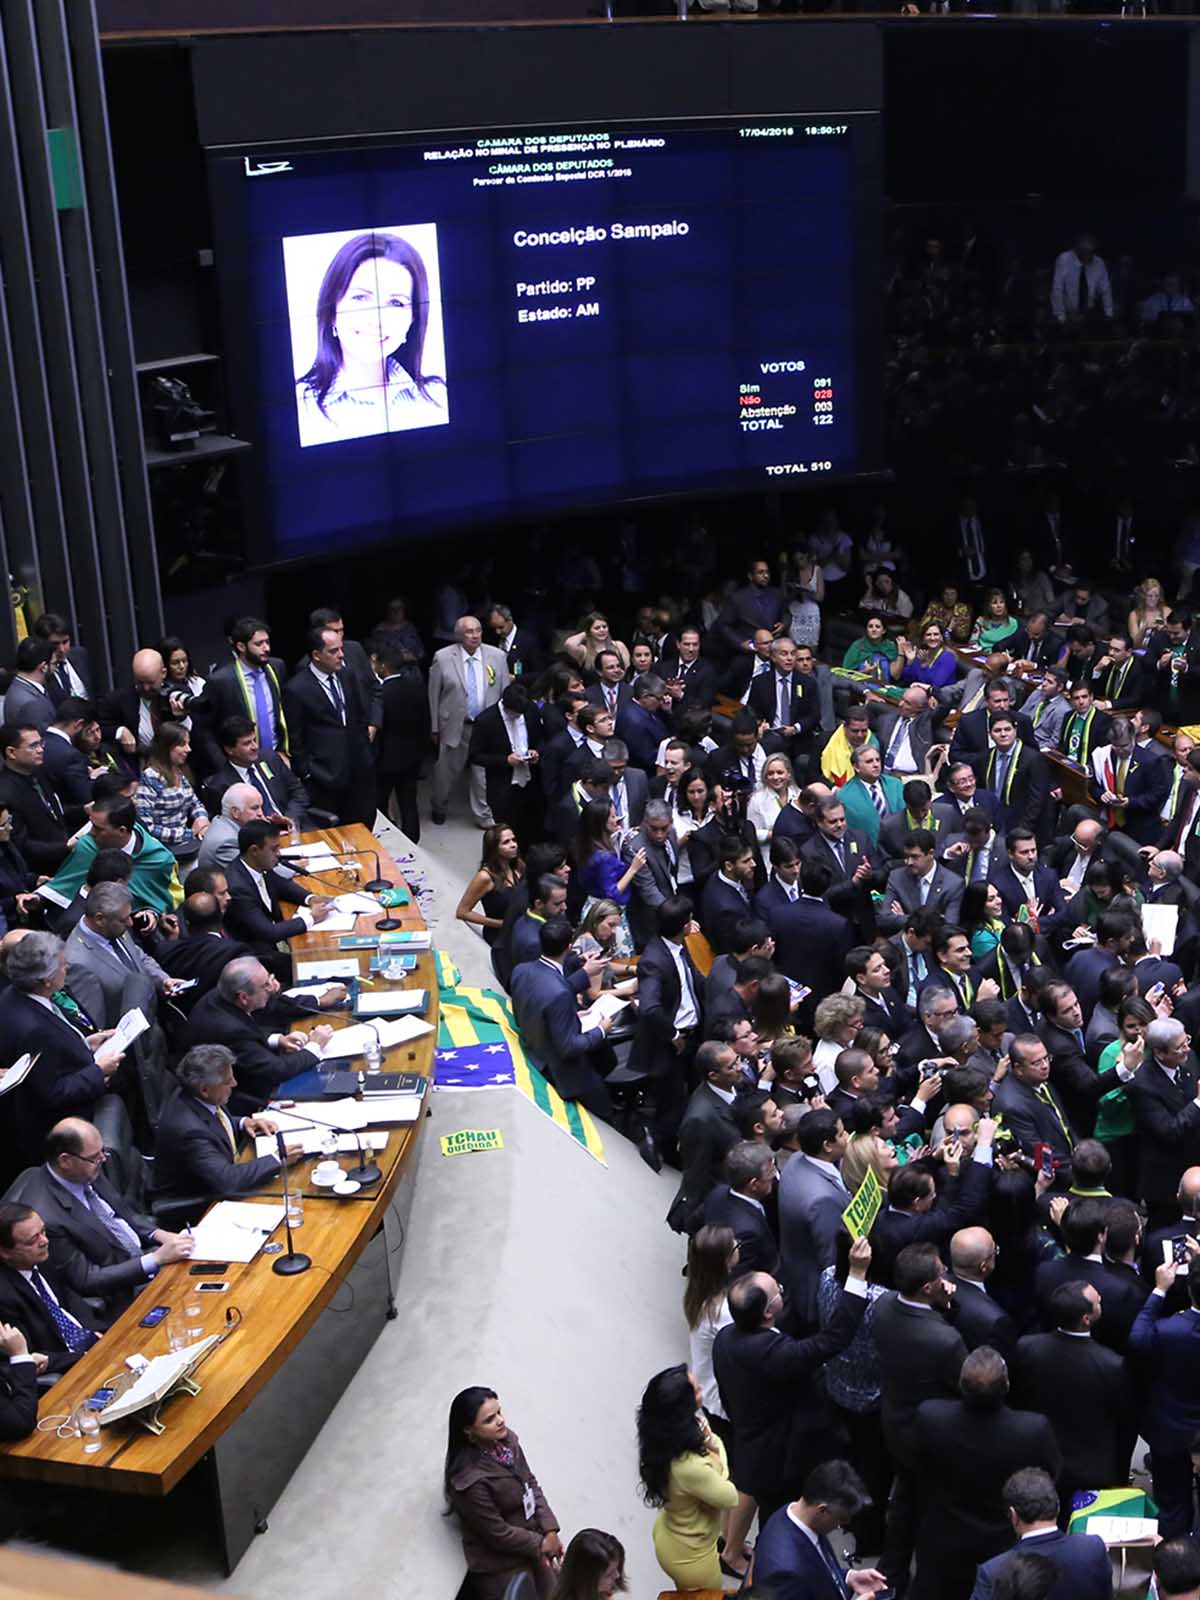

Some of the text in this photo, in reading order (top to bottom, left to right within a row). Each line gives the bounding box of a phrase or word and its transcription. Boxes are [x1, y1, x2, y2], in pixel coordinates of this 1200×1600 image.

[524, 136, 547, 145] DOS
[548, 133, 610, 143] DEPUTADOS
[423, 148, 474, 160] RELAÇÃO
[523, 145, 539, 154] DE
[540, 142, 595, 152] PRESENÇA
[596, 141, 611, 150] NO
[614, 138, 666, 149] PLENÁRIO
[488, 159, 614, 175] CÂMARA DOS DEPUTADOS
[513, 220, 690, 247] Conceição Sampaio
[516, 276, 596, 297] Partido: PP
[518, 302, 600, 323] Estado: AM
[760, 360, 806, 374] VOTOS
[739, 378, 832, 393] Sim 091
[739, 395, 761, 405] Não
[740, 404, 797, 418] Abstenção
[740, 414, 833, 431] TOTAL 122
[765, 461, 832, 475] TOTAL 510
[446, 1131, 497, 1146] TCHAU
